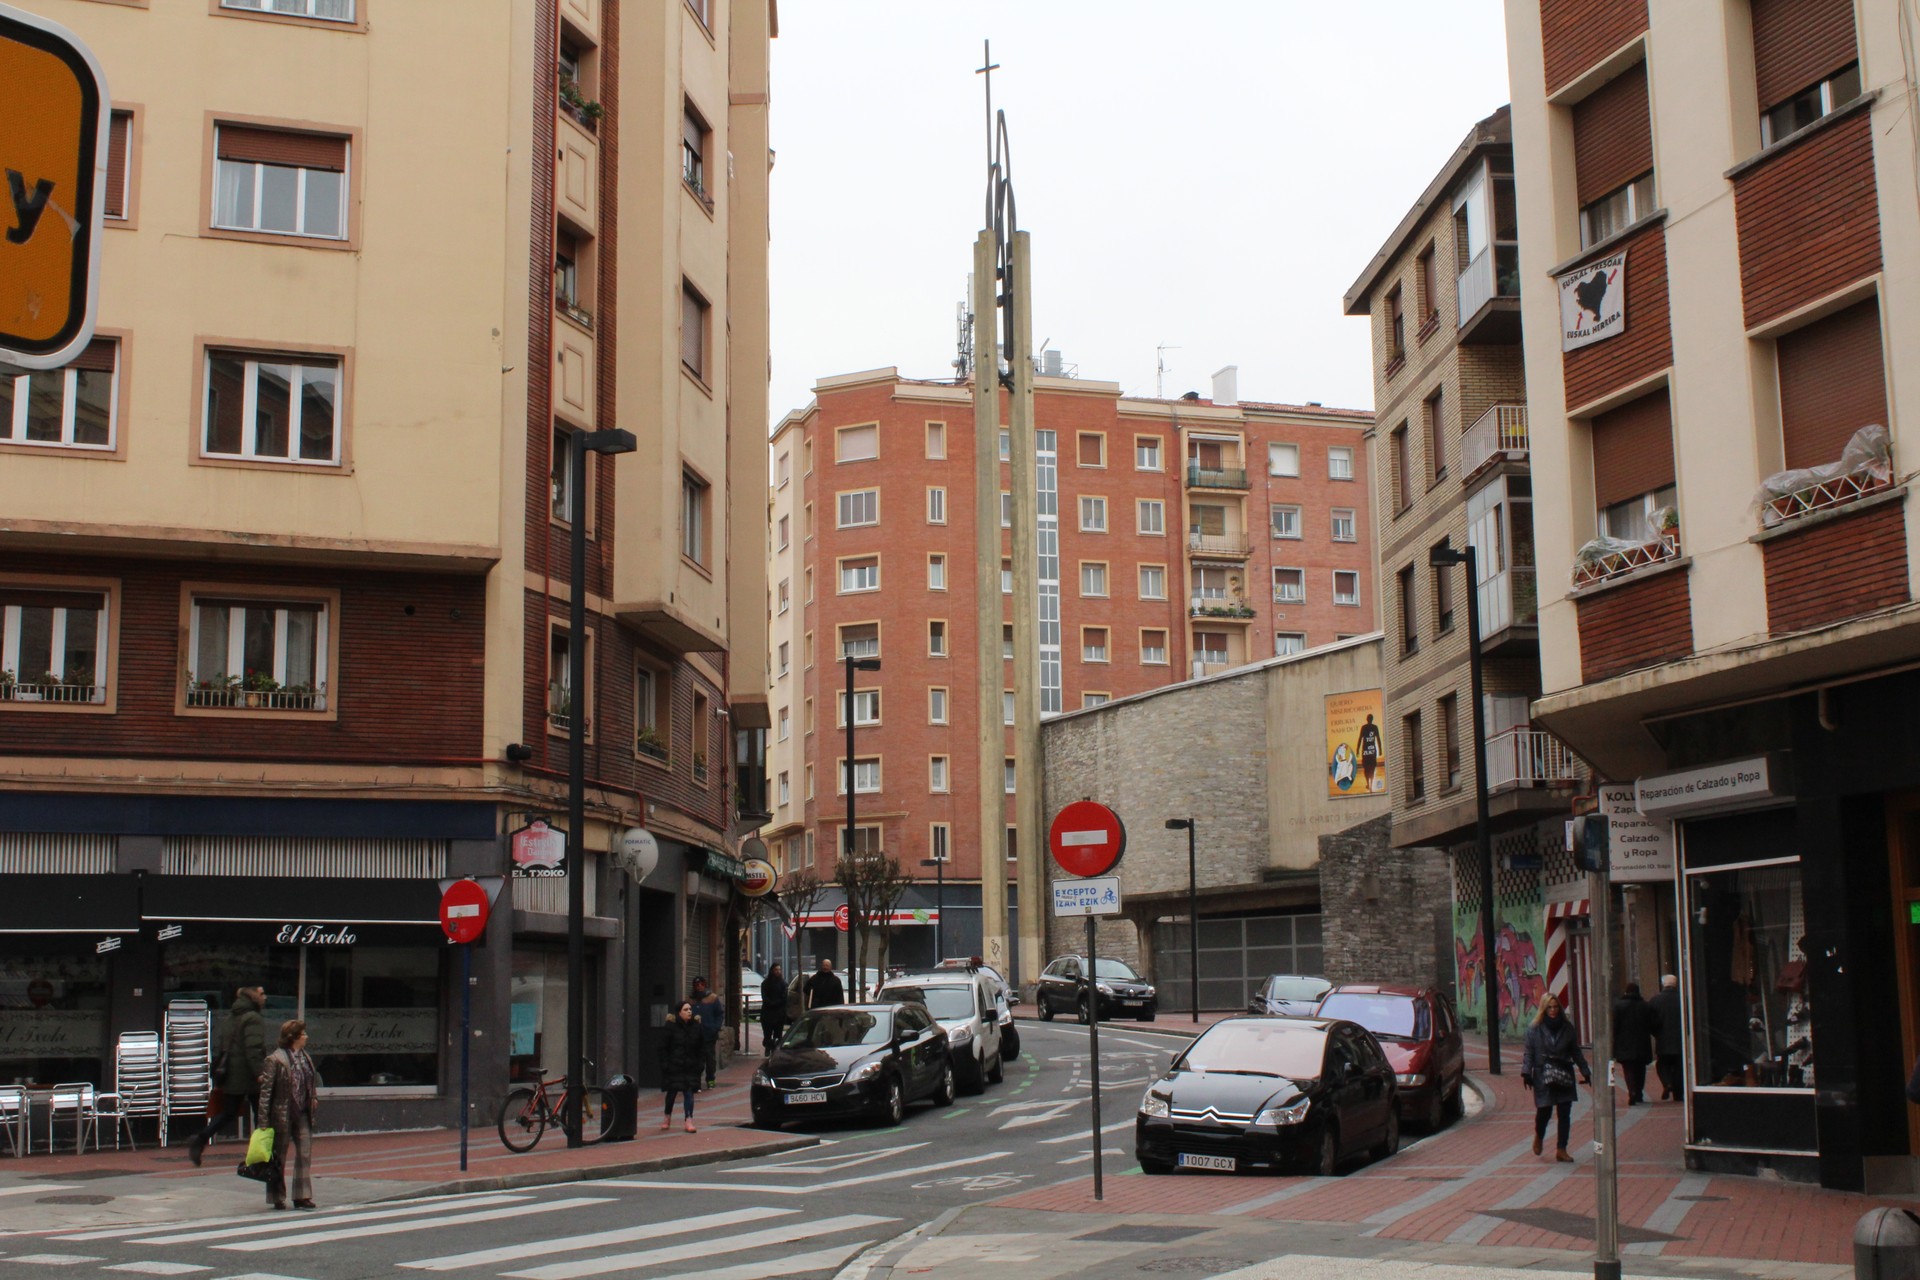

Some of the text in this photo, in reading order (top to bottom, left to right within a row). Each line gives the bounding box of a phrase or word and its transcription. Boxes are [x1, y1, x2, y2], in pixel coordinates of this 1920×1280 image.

[1562, 257, 1623, 290] EUSKAL PRESOAK
[1566, 329, 1591, 339] EUSKAL
[1640, 772, 1760, 800] Reparación de Calzado y Ropa
[1606, 792, 1636, 802] KOLL
[1614, 806, 1636, 814] Zapa
[1611, 820, 1655, 829] Reparac
[1620, 834, 1659, 843] Calzado
[1632, 849, 1658, 857] Ropa
[511, 869, 565, 878] EL TXOKO
[1055, 888, 1097, 897] EXCEPTO
[1080, 898, 1099, 906] EZIK
[276, 924, 357, 944] El Txoko
[336, 1023, 405, 1039] El Txoko
[790, 1093, 825, 1102] 9460 HCV
[1186, 1155, 1233, 1169] 1007 GCX
